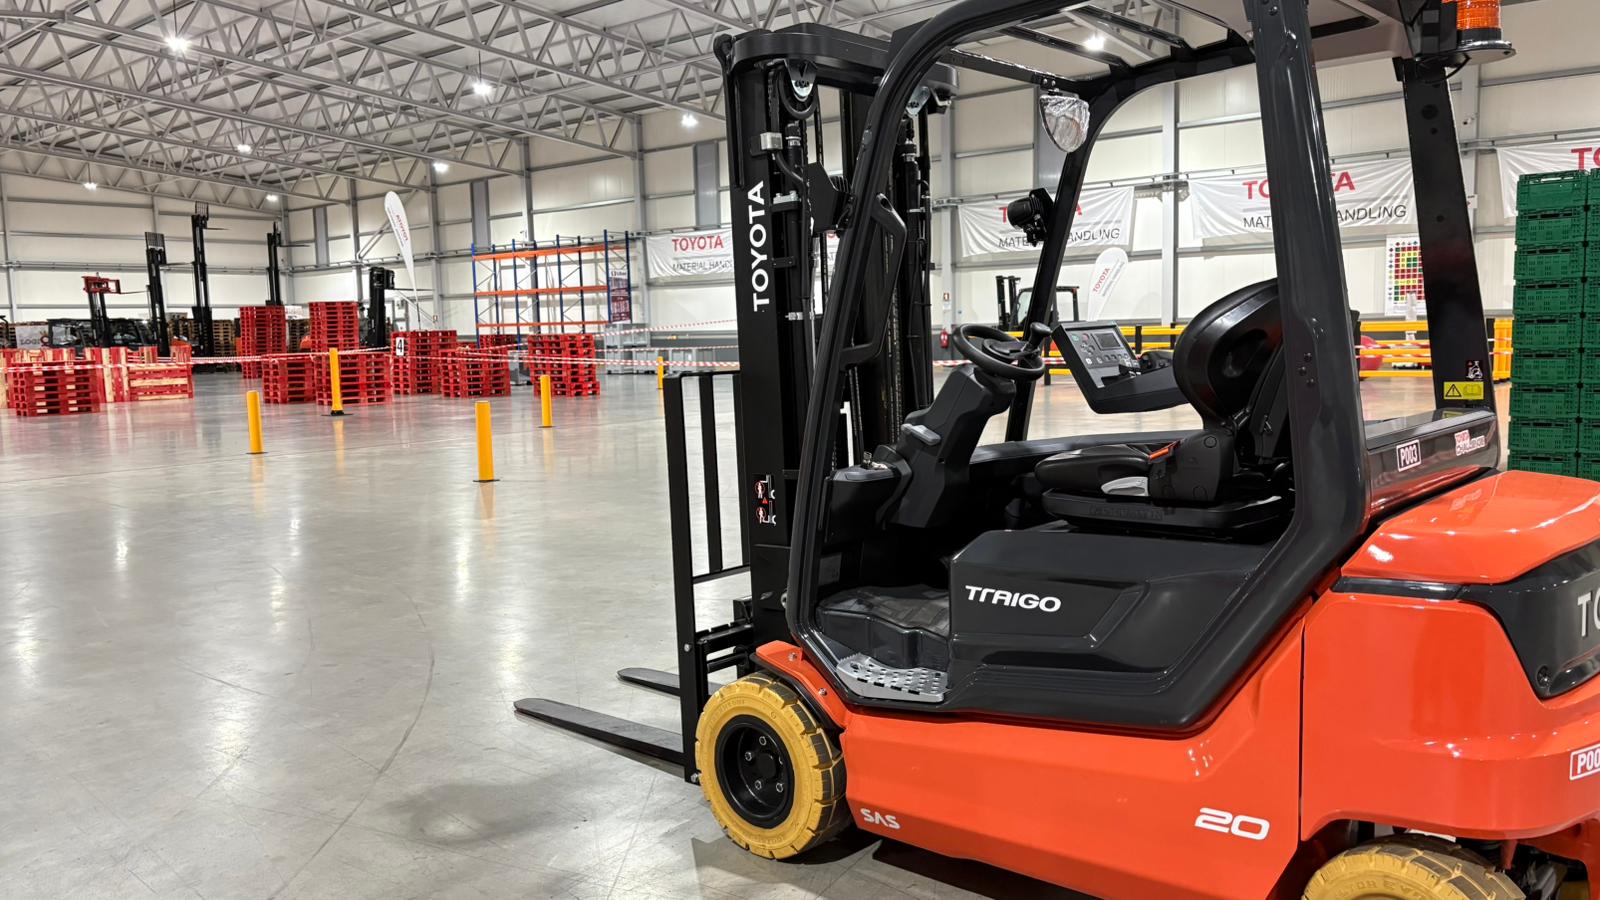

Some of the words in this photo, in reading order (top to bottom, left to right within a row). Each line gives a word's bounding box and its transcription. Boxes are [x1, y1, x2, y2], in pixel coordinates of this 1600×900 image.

[1336, 204, 1407, 222] ANDLING
[671, 235, 724, 252] TOYOTA
[747, 180, 770, 312] TOYOTA
[1068, 228, 1120, 243] ANDLING
[1093, 267, 1110, 292] TOYOTA
[397, 339, 402, 353] 4
[1400, 445, 1418, 467] P003
[965, 585, 1062, 612] TRAIGO
[1577, 748, 1600, 774] P00
[860, 808, 900, 829] SAS
[1195, 807, 1270, 840] 20
